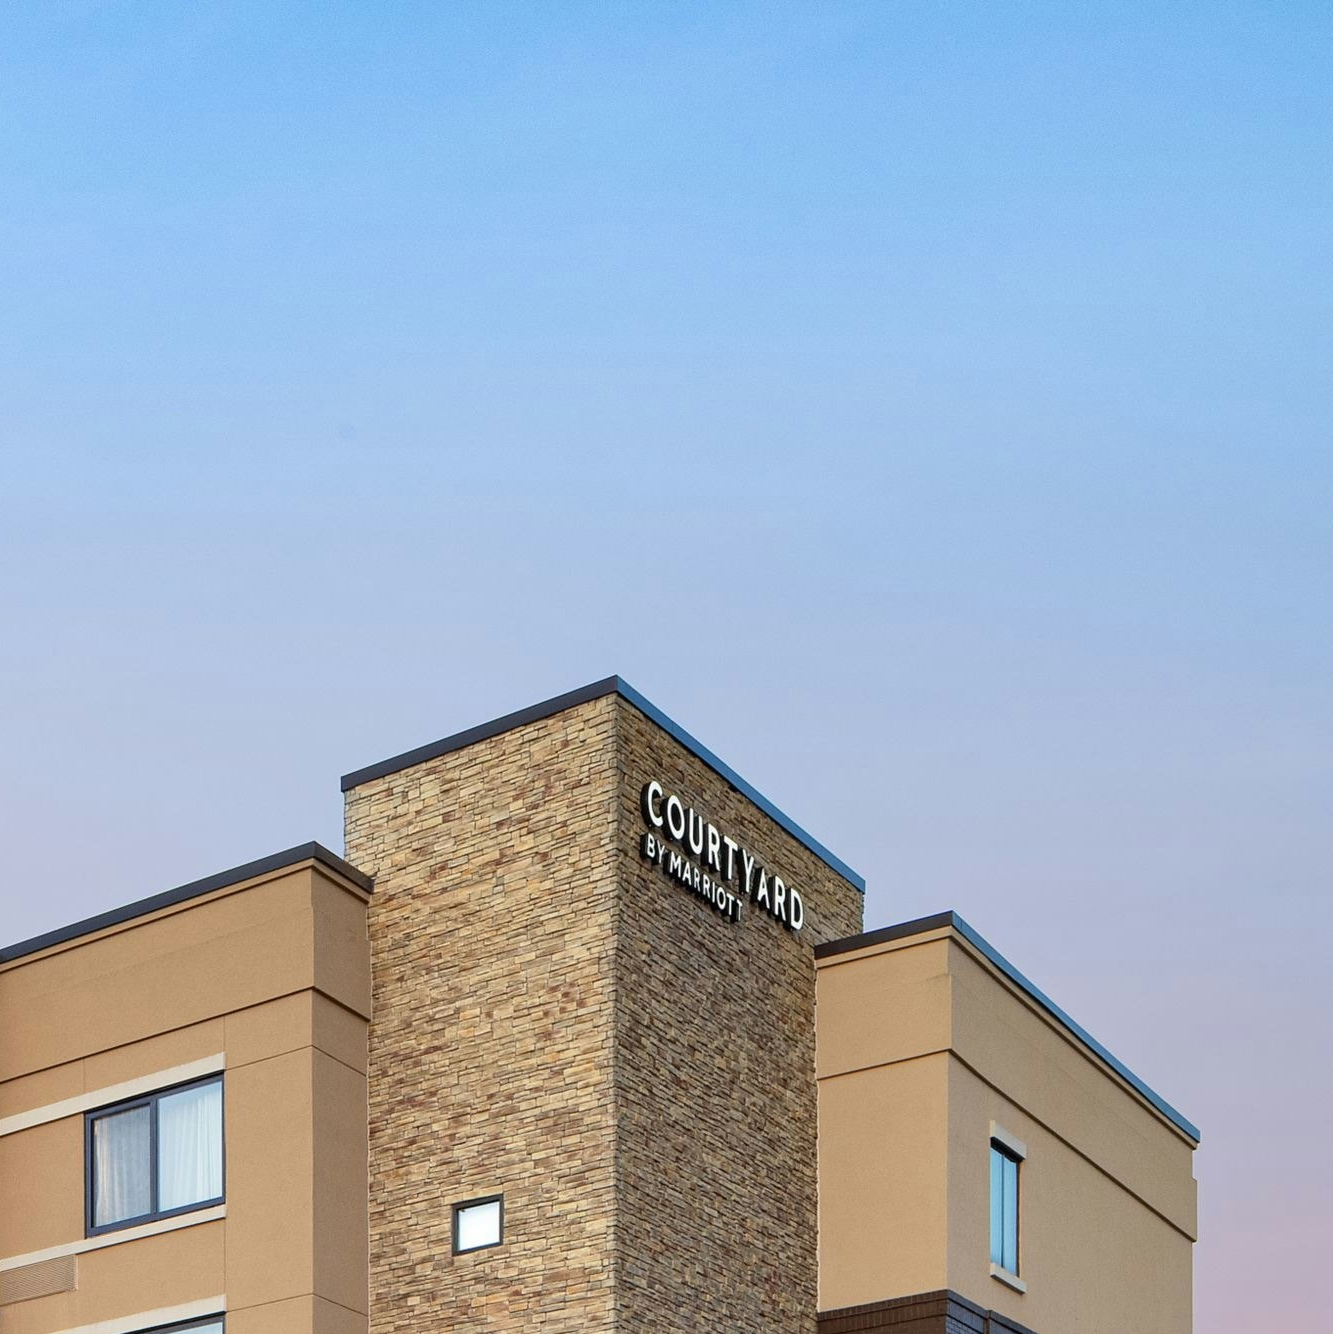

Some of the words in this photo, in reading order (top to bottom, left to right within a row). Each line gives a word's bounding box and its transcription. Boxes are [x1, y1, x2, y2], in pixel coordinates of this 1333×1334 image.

[646, 780, 805, 931] COURTYARD
[646, 833, 666, 865] BY
[668, 850, 744, 922] MARRIOTT
